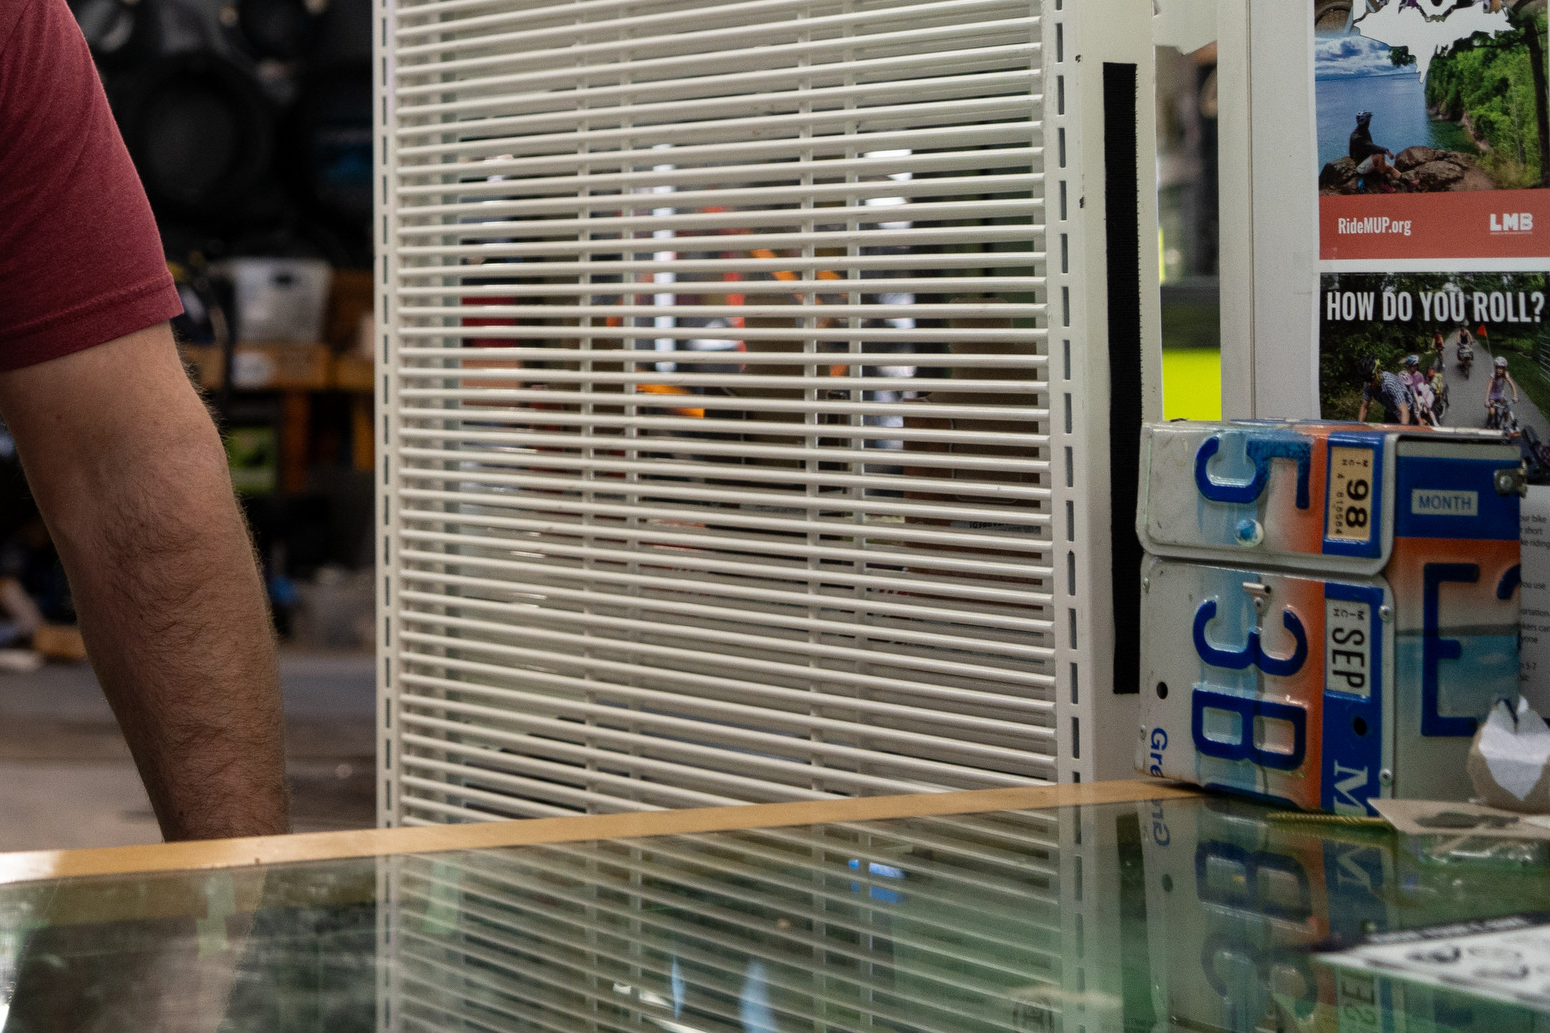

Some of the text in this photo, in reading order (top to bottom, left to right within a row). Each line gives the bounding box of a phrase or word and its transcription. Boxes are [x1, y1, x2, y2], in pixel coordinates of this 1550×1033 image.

[1338, 216, 1412, 236] RideMUP.org
[1489, 212, 1534, 232] LMB
[1326, 291, 1546, 323] HOW DO YOU ROLL?
[1345, 479, 1369, 528] 98
[1418, 495, 1472, 510] MONTH
[1332, 626, 1366, 689] SEP
